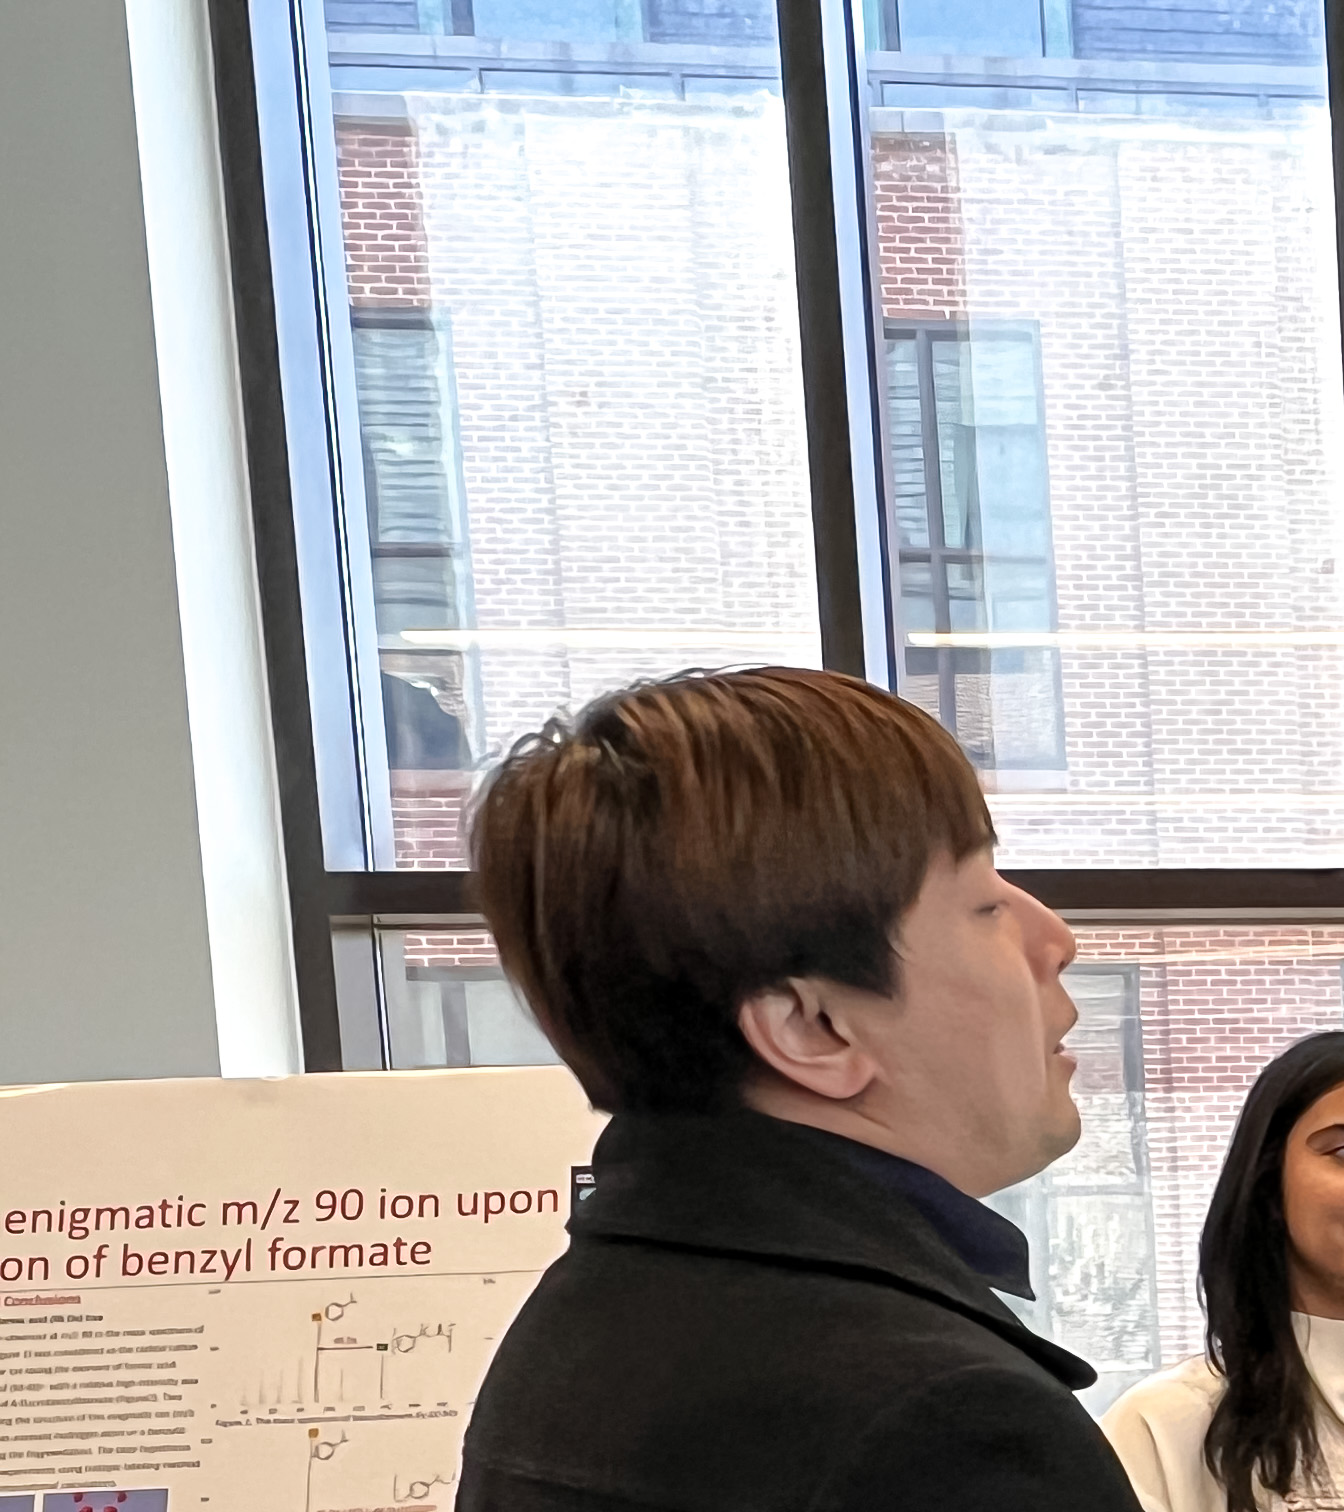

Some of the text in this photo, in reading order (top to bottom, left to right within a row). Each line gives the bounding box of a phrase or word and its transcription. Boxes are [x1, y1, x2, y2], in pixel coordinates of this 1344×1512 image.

[4, 1186, 560, 1240] enigmatic m/z 90 ion upon
[0, 1236, 432, 1282] on of benzyl formate
